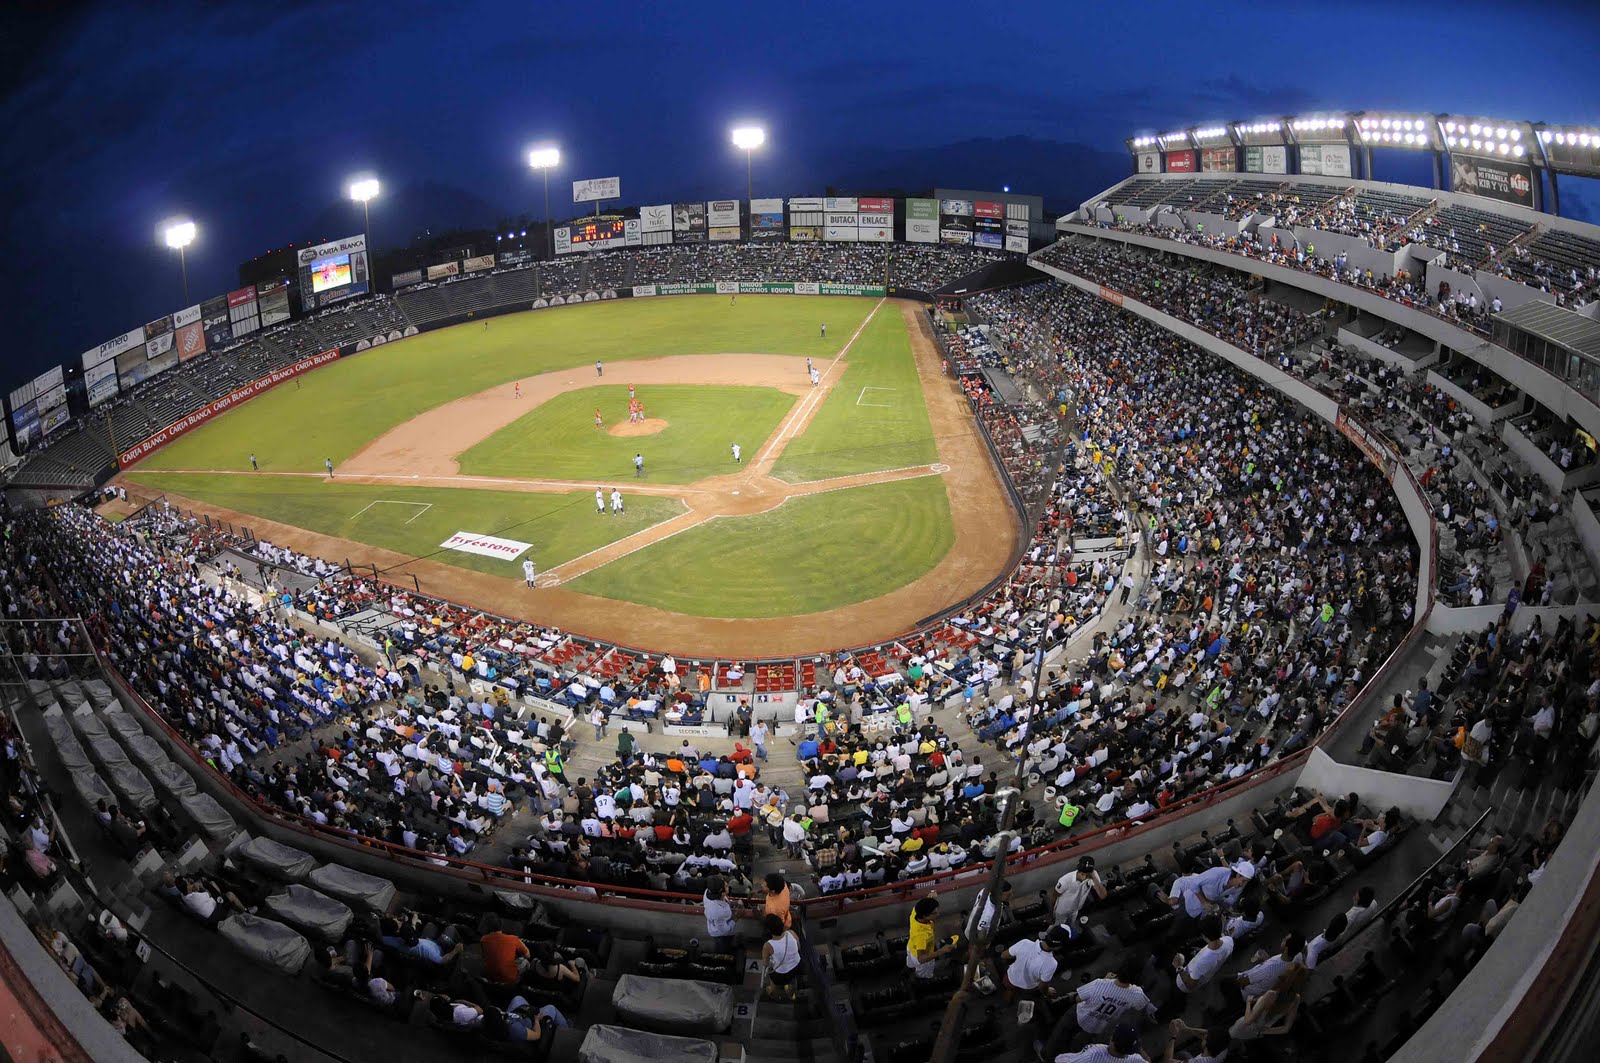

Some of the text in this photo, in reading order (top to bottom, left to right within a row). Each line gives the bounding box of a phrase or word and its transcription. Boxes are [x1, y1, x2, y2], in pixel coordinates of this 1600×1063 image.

[1479, 179, 1490, 189] KIR
[1491, 181, 1497, 190] Y
[830, 216, 856, 224] BUTACA
[862, 217, 888, 225] ENLACE
[319, 247, 339, 257] CARTA
[340, 240, 364, 251] BLANCA
[100, 334, 129, 357] primero
[295, 351, 337, 372] CARTA BLANCA
[254, 368, 294, 390] CARTA BLANCA
[213, 387, 253, 411] CARTA BLANCA
[169, 408, 211, 435] CARTA BLANCA
[122, 433, 167, 463] CARTA BLANCA
[449, 536, 519, 554] Firestone
[598, 798, 608, 807] 37
[749, 961, 759, 970] A
[737, 1006, 748, 1016] B
[1096, 1003, 1117, 1015] 10
